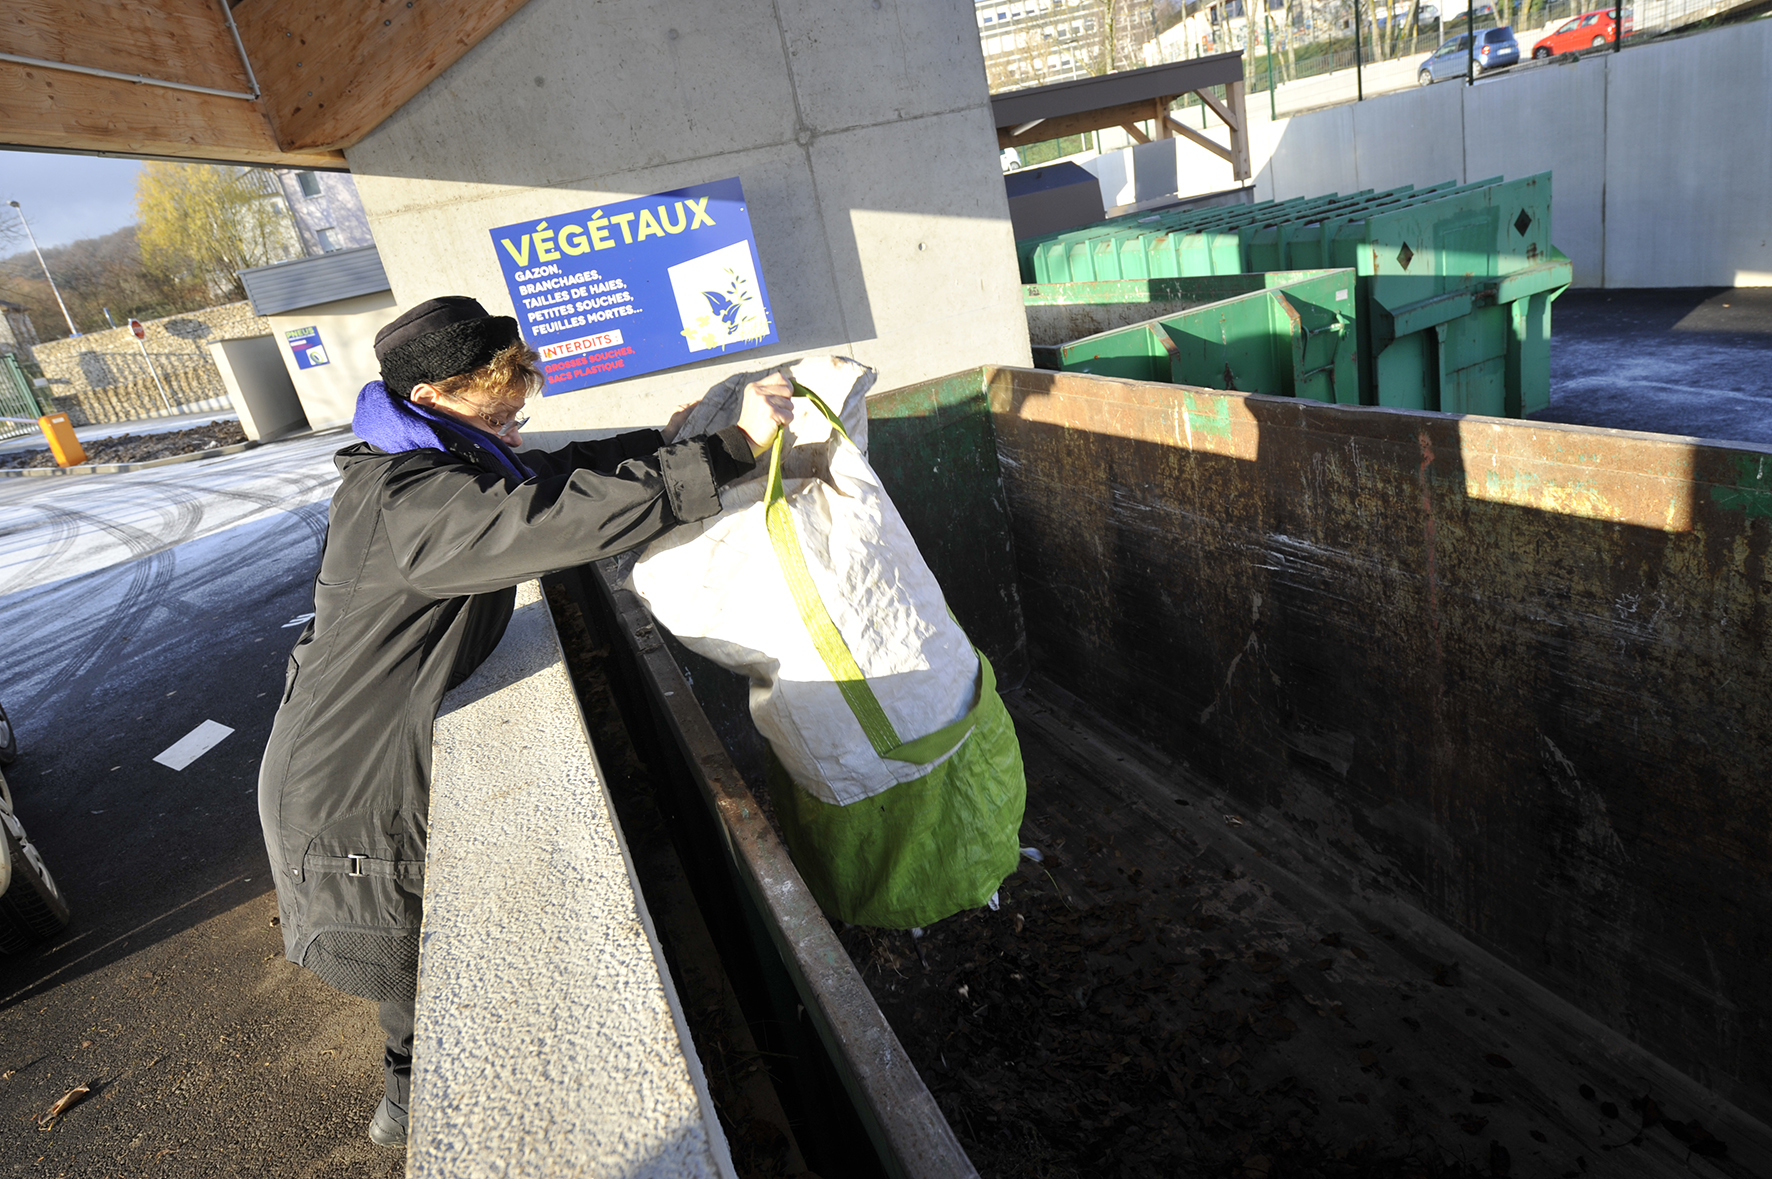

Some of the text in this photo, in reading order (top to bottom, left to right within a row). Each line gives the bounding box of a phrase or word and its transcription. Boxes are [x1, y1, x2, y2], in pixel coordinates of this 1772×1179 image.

[501, 196, 716, 267] VÉGÉTAUX
[515, 264, 562, 282] GAZON,
[519, 270, 602, 296] BRANCHAGES,
[522, 279, 627, 309] TAILLES DE HAIES,
[527, 291, 634, 323] PETITES SOUCHES,
[532, 305, 643, 336] FEUILLES MORTES...
[543, 334, 612, 358] INTERDITS
[544, 346, 636, 373] GROSSES SOUCHES,
[548, 360, 625, 384] SACS PLASTIQUE
